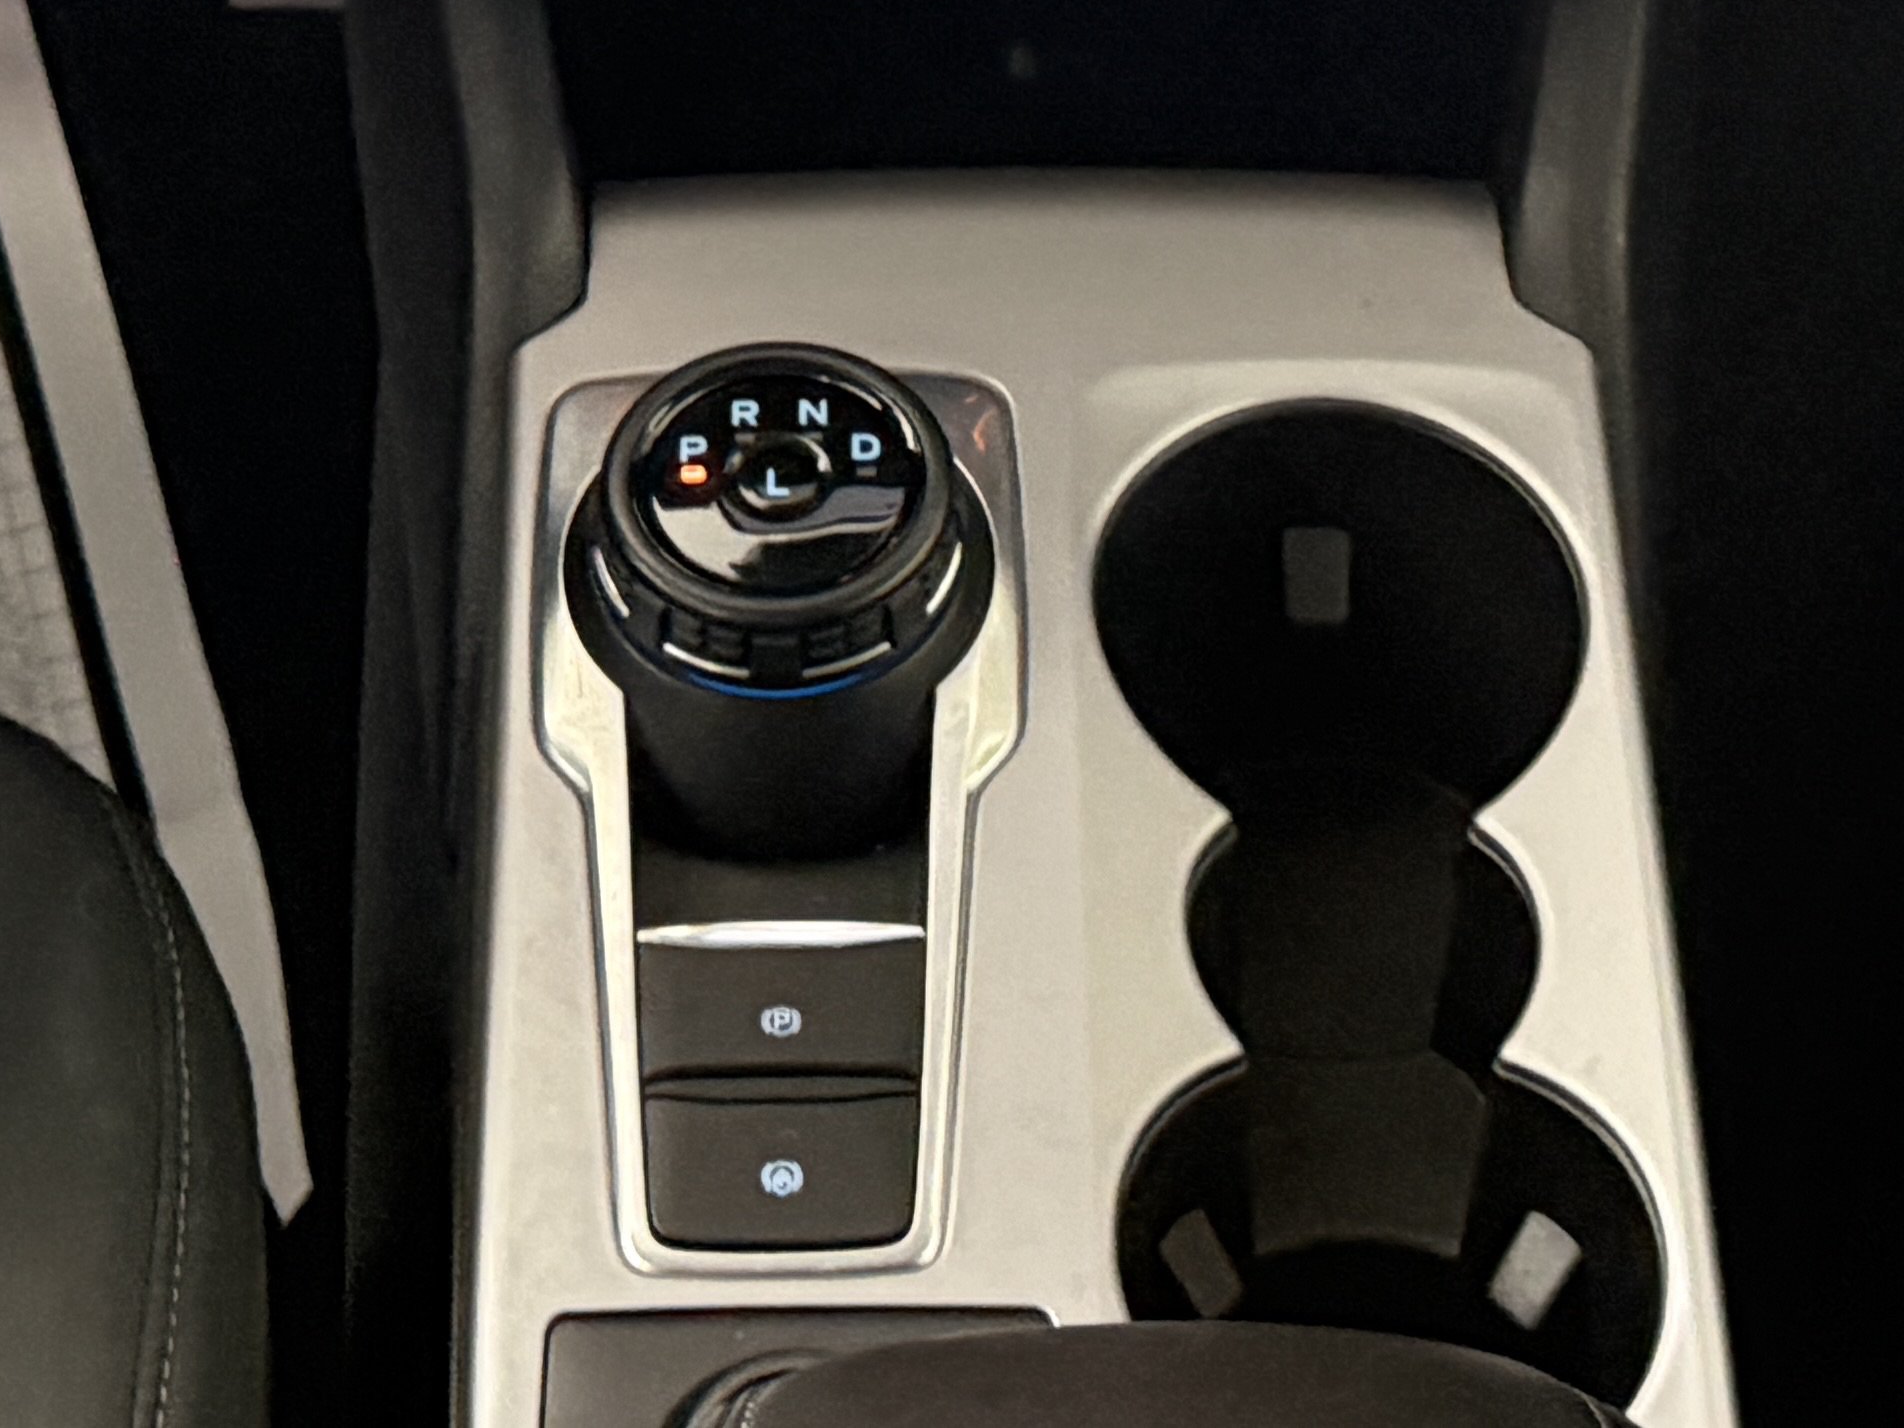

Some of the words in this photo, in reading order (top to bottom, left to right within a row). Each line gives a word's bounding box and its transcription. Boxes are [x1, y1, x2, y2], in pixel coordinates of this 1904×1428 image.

[679, 435, 708, 461] P
[731, 399, 760, 426] R
[798, 399, 828, 426] N
[850, 433, 882, 461] D
[765, 467, 790, 498] L
